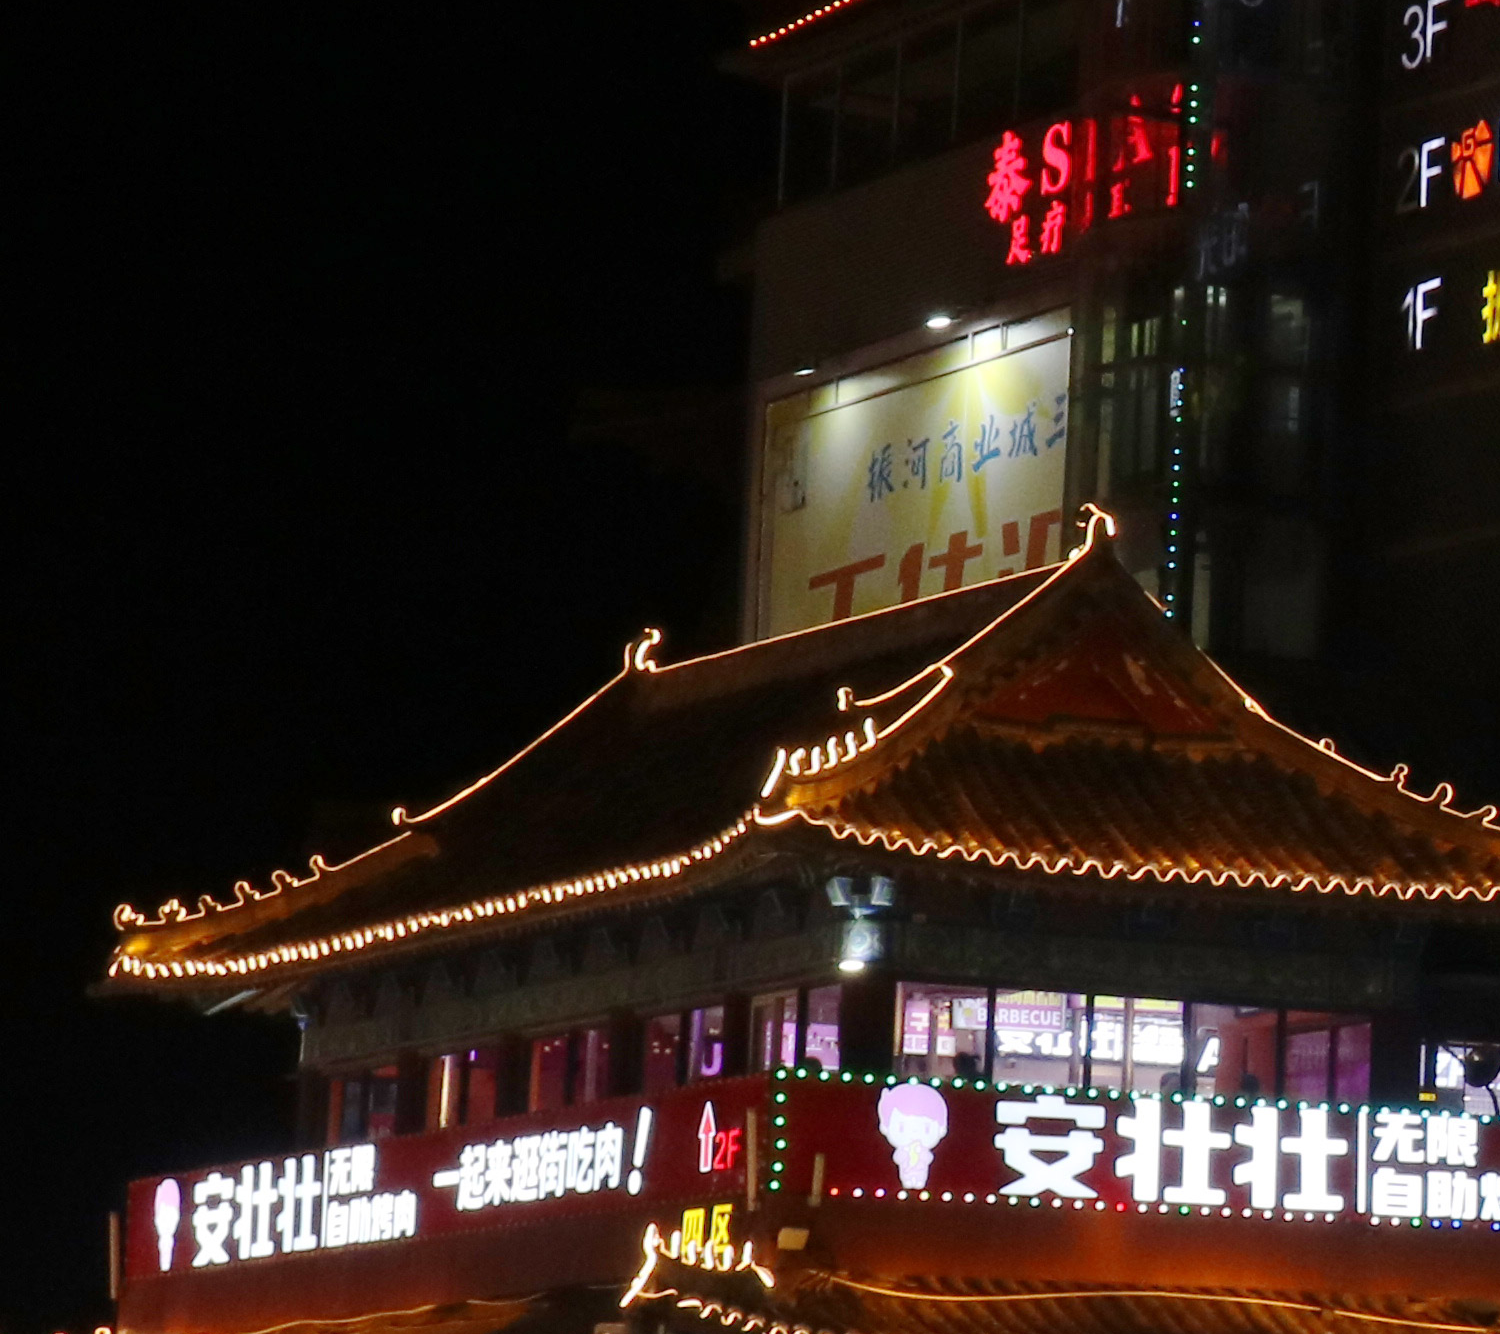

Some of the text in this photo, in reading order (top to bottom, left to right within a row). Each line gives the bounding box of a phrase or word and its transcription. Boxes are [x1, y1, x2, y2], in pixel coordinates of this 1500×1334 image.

[433, 1105, 653, 1211] 一起来逛街吃肉！
[712, 1128, 743, 1170] 2F
[993, 1094, 1479, 1212] 安壮壮 无限
[191, 1144, 376, 1267] 安壮壮 无限
[326, 1190, 417, 1249] 自助烤肉
[680, 1203, 733, 1261] 四区
